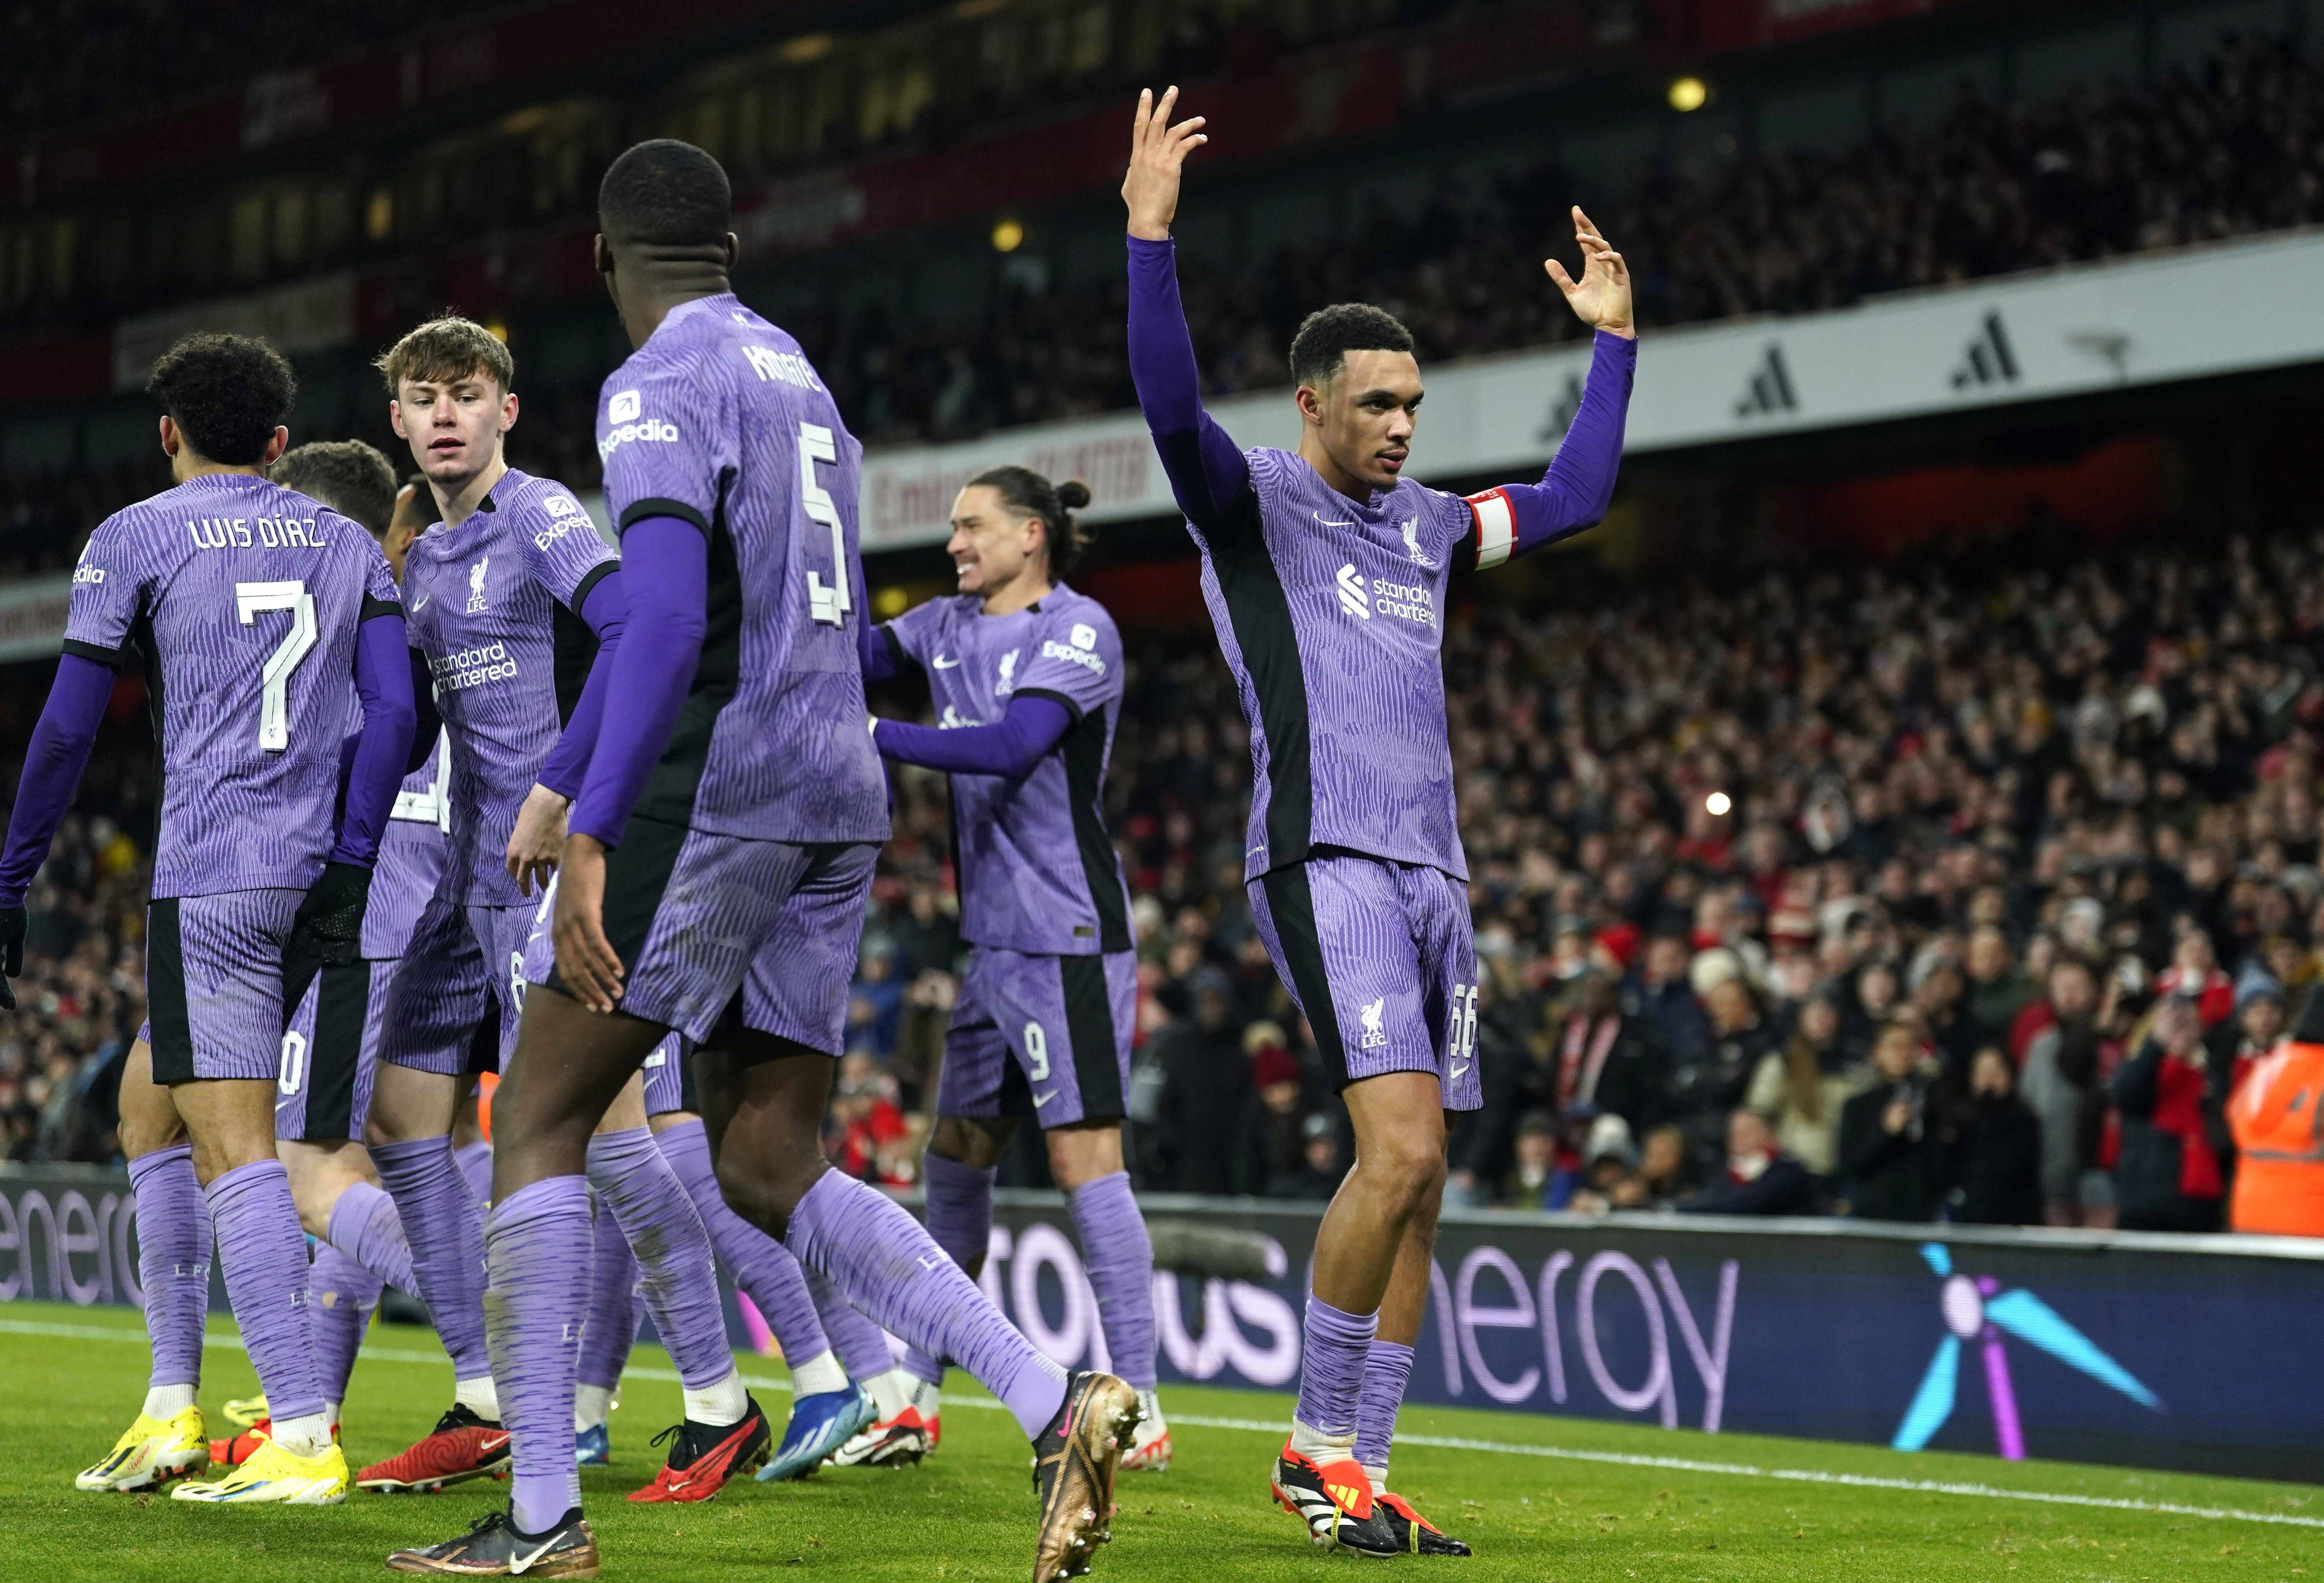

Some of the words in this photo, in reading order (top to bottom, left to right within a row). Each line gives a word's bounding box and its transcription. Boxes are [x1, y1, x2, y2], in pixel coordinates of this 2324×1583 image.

[188, 518, 253, 548] LUIS
[257, 514, 326, 548] DÍAZ
[798, 421, 851, 626] 5
[236, 580, 319, 751] 7
[434, 640, 505, 674] standard
[437, 657, 517, 693] chartered
[280, 1030, 306, 1096] 0
[1024, 1021, 1050, 1082] 9
